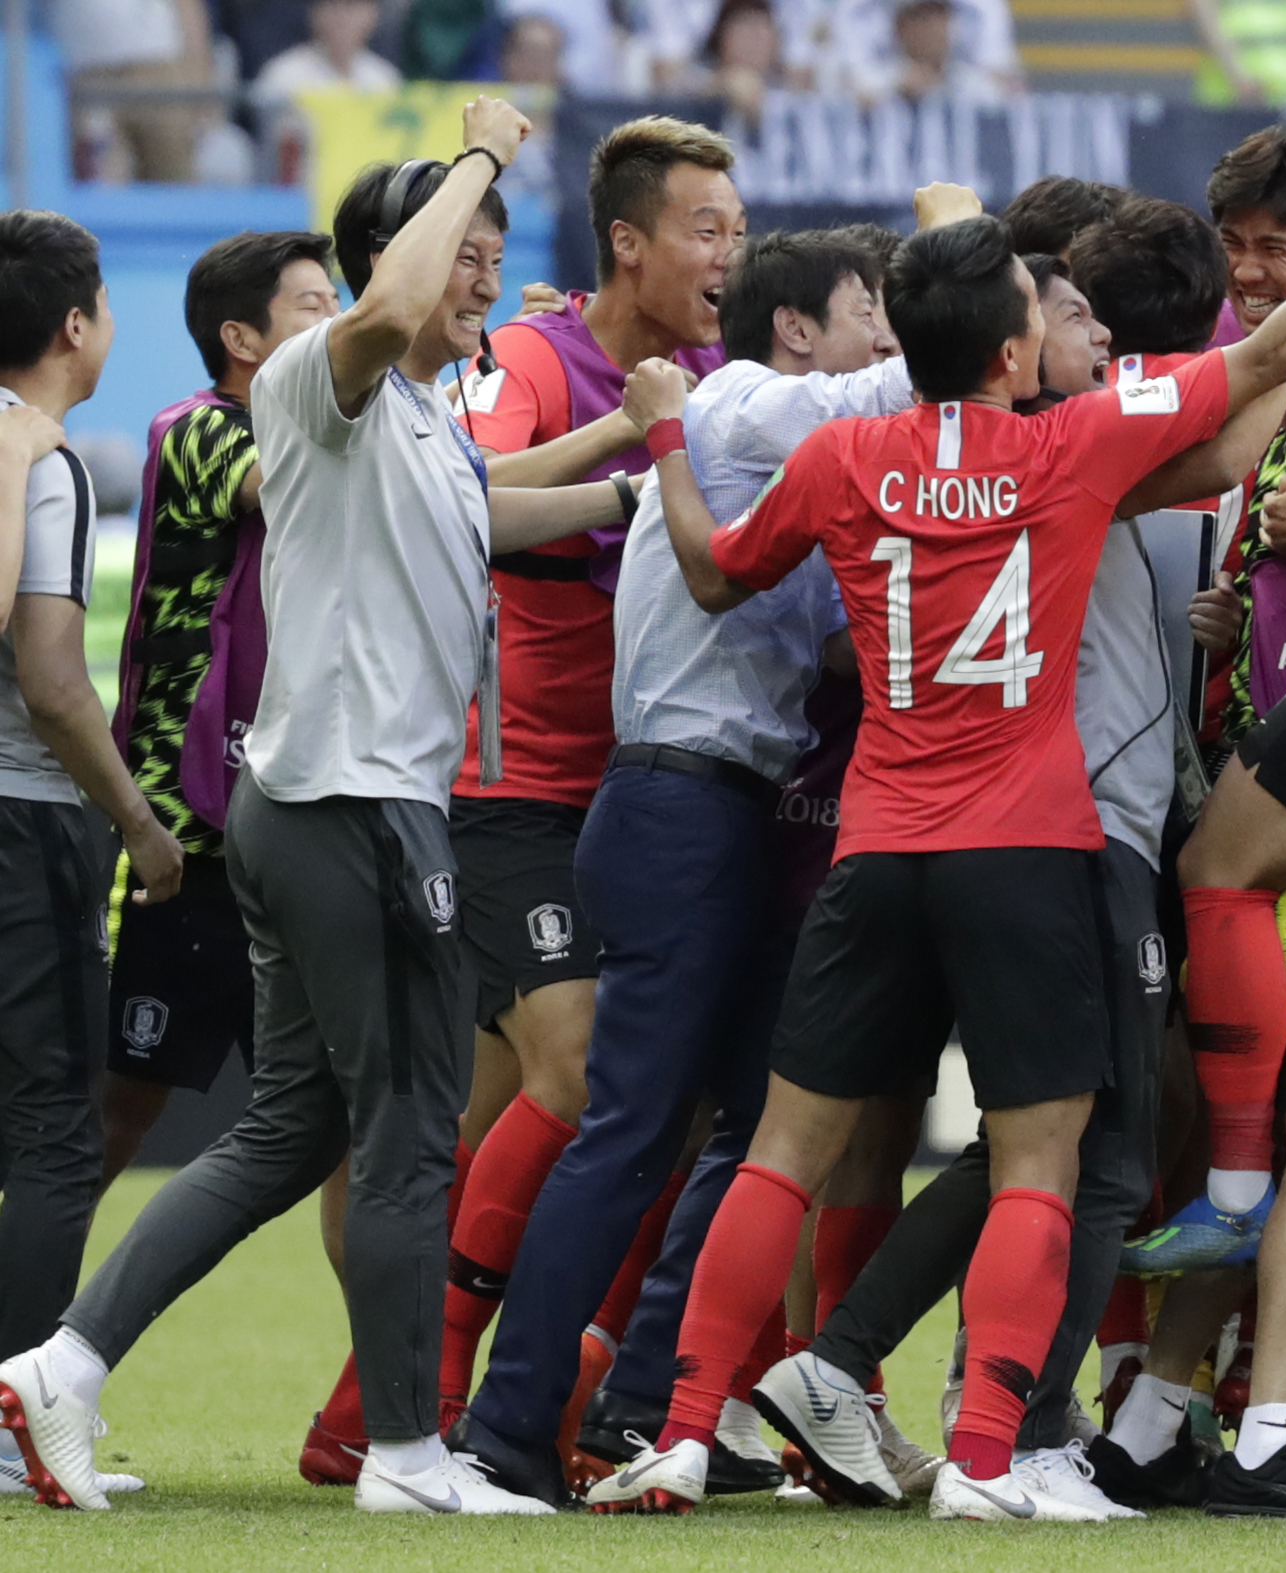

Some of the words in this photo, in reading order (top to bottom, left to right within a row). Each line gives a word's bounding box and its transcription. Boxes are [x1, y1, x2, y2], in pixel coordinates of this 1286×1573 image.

[879, 470, 906, 513] C
[916, 474, 1018, 520] HONG
[870, 527, 1045, 709] 14
